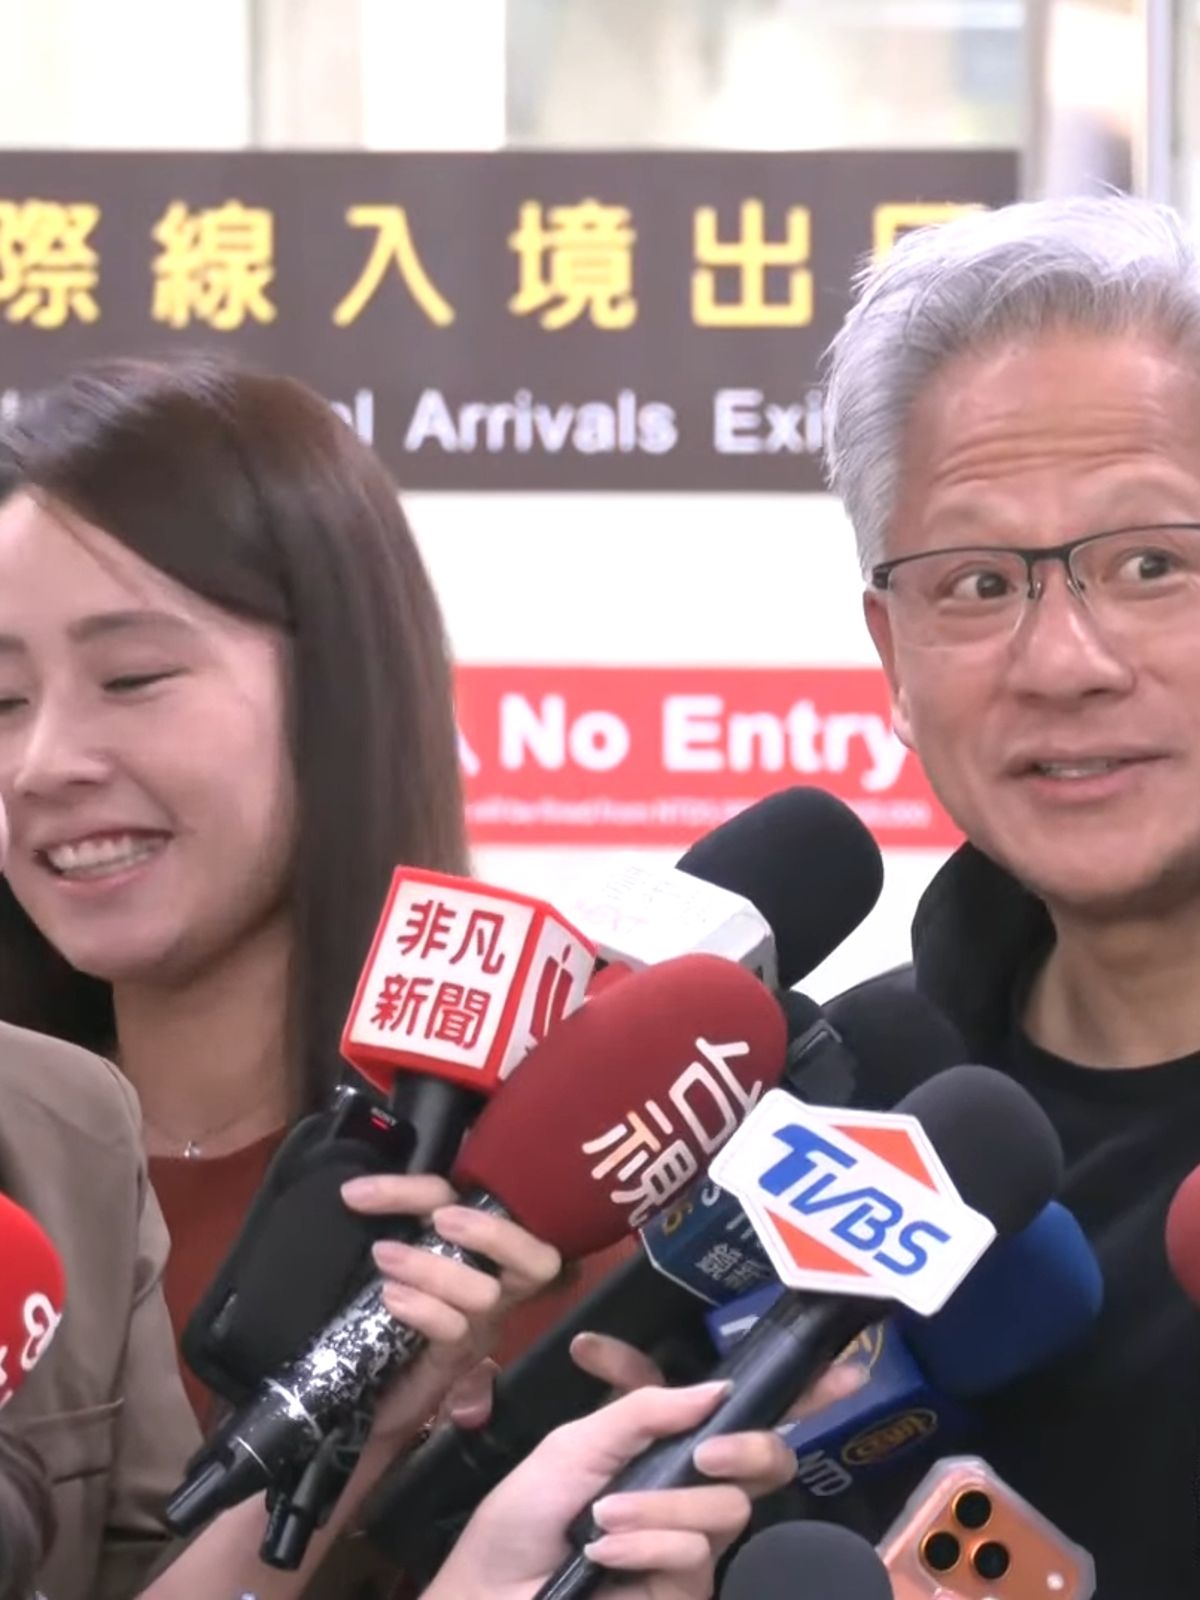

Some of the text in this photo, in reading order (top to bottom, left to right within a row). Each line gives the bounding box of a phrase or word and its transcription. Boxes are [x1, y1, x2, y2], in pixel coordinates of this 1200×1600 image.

[404, 388, 678, 454] Arrivals
[713, 387, 823, 454] Exi
[500, 692, 632, 772] No
[662, 694, 911, 792] Entry
[396, 900, 506, 975] 非凡
[370, 973, 493, 1050] 新聞
[757, 1122, 951, 1277] TVBS
